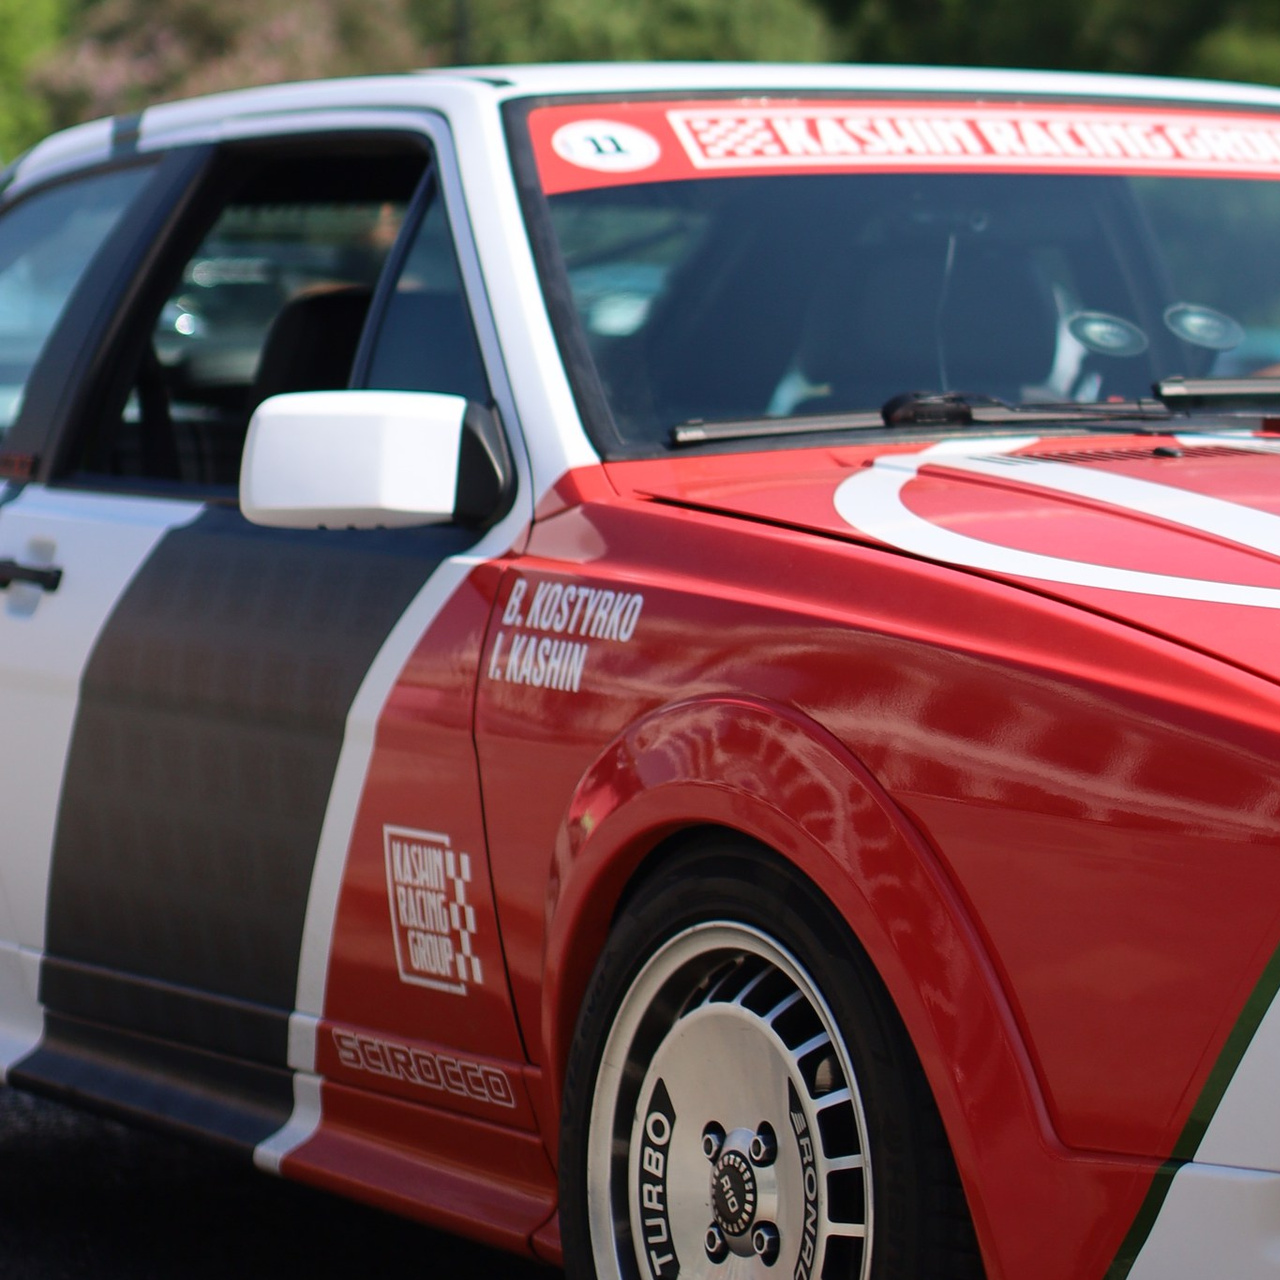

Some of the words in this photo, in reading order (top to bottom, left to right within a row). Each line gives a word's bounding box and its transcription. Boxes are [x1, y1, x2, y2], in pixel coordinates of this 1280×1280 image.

[769, 118, 984, 155] KASHIN
[974, 120, 1176, 158] RACING
[502, 578, 527, 626] B.
[526, 581, 644, 643] KOSTYRKO
[505, 634, 589, 693] KASHIN
[392, 841, 446, 892] KASHIN
[396, 884, 450, 935] RACING
[407, 928, 454, 977] GROUP
[332, 1027, 516, 1109] SCIROCCO
[642, 1111, 674, 1276] TURBO
